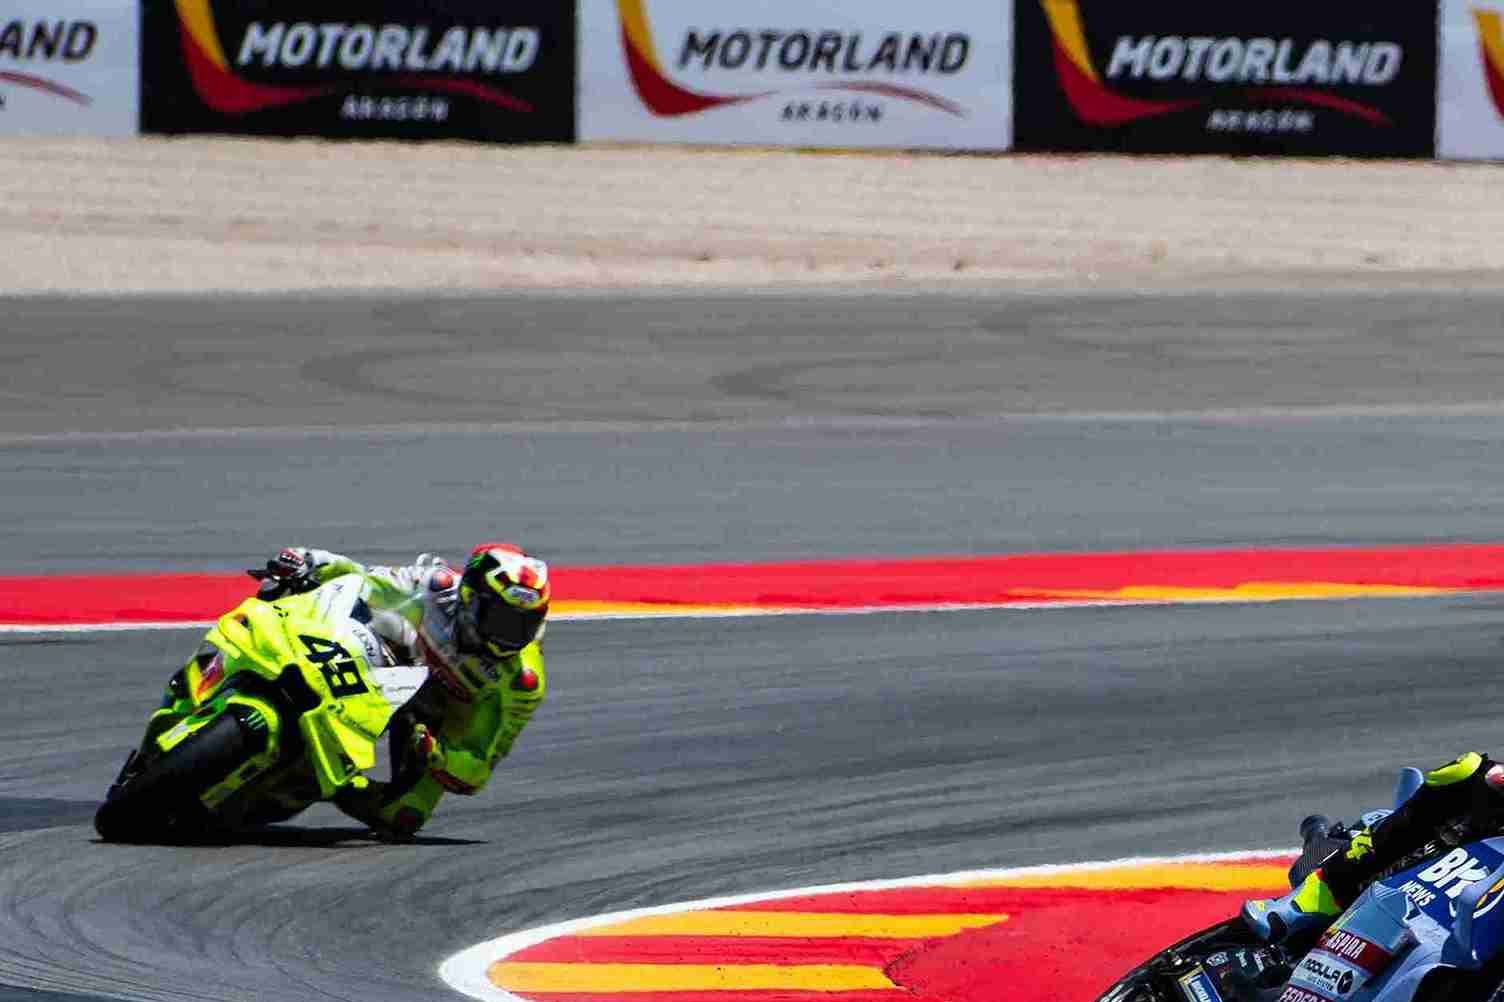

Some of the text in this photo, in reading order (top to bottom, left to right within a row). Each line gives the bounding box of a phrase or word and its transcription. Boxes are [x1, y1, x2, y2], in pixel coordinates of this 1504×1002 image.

[239, 23, 539, 72] MOTORLAND
[677, 31, 971, 76] MOTORLAND
[1107, 36, 1401, 84] MOTORLAND
[298, 634, 368, 698] 49
[1398, 879, 1437, 907] NEWS
